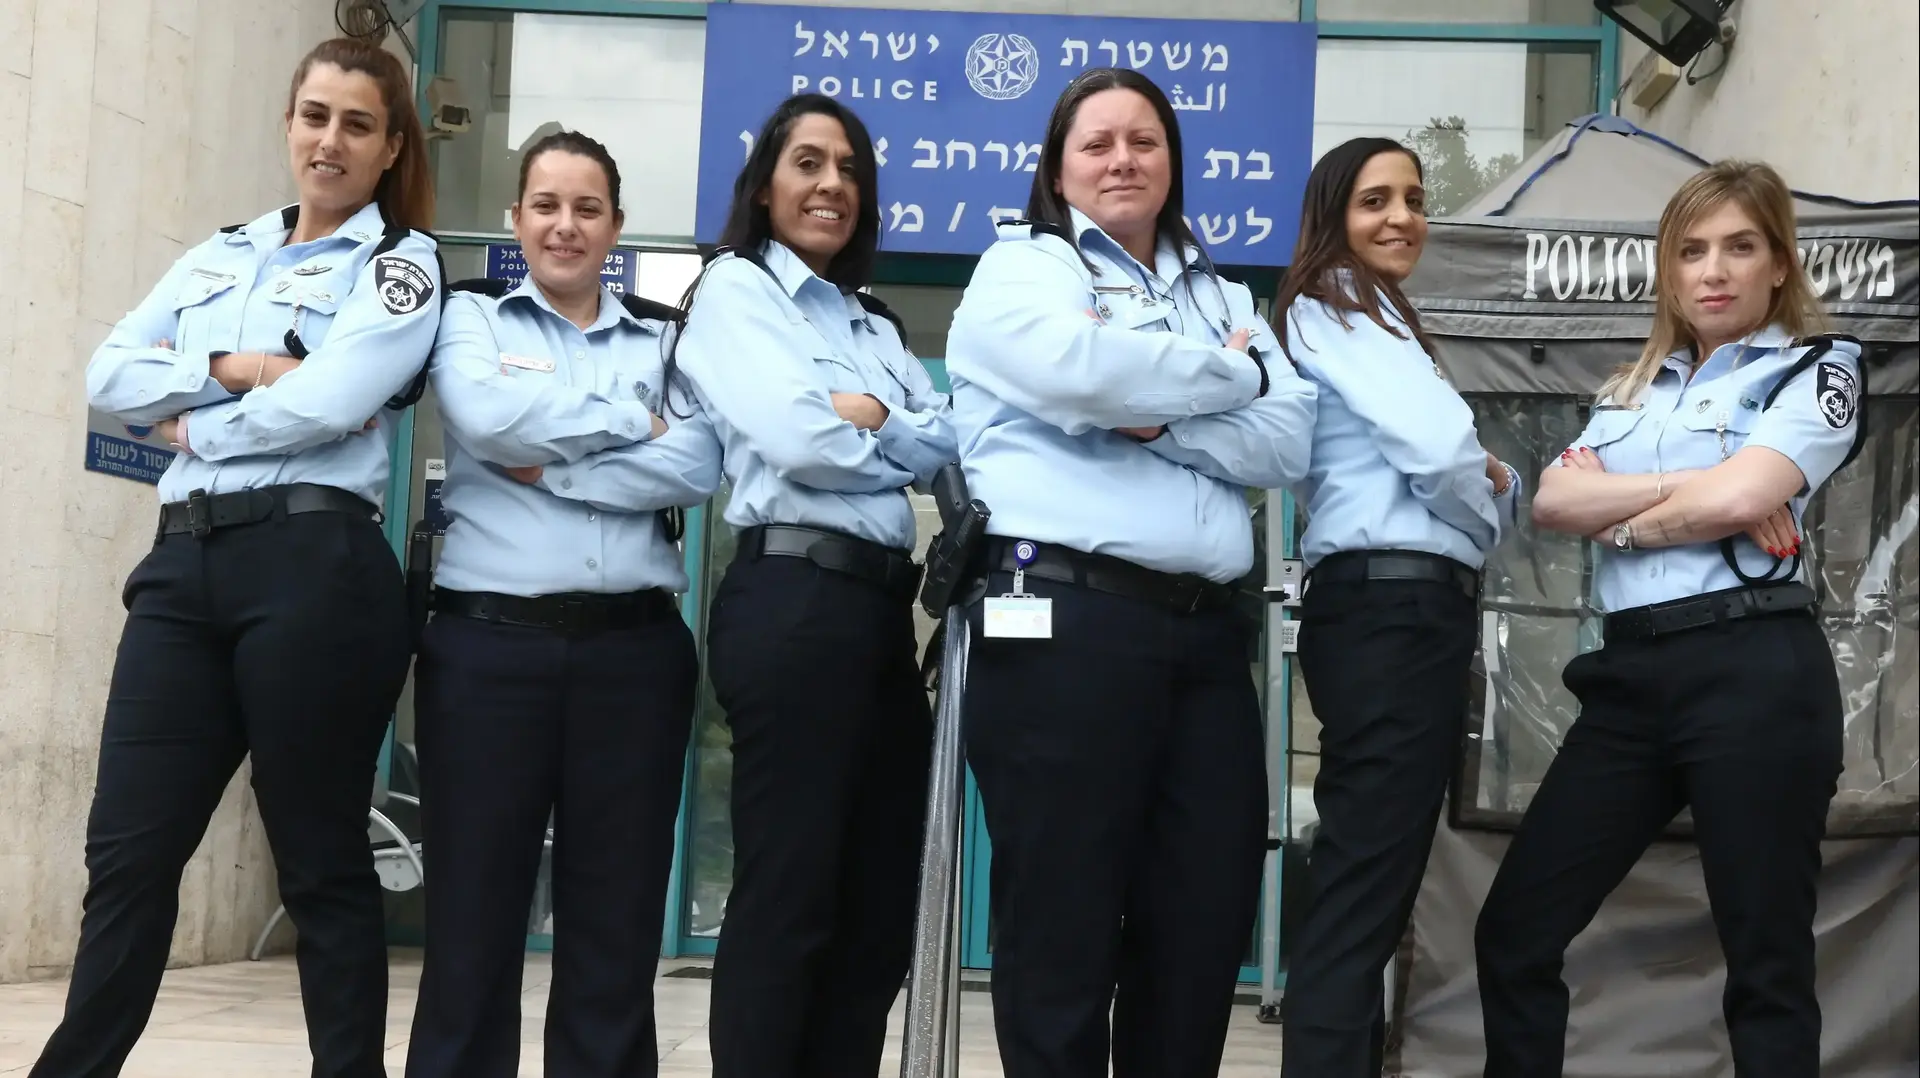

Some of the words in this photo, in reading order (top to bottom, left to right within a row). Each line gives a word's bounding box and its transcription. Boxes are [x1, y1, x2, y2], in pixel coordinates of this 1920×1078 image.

[795, 21, 940, 60] ישראל
[1060, 38, 1228, 71] משטרת
[793, 75, 938, 101] POLICE
[1171, 83, 1227, 112] الش
[912, 137, 1043, 172] מרחב
[1203, 148, 1274, 181] בת
[381, 258, 409, 269] ישראל
[500, 263, 530, 271] POLI
[501, 248, 525, 260] ראל
[1797, 239, 1895, 300] משט
[95, 436, 138, 463] לעשן!
